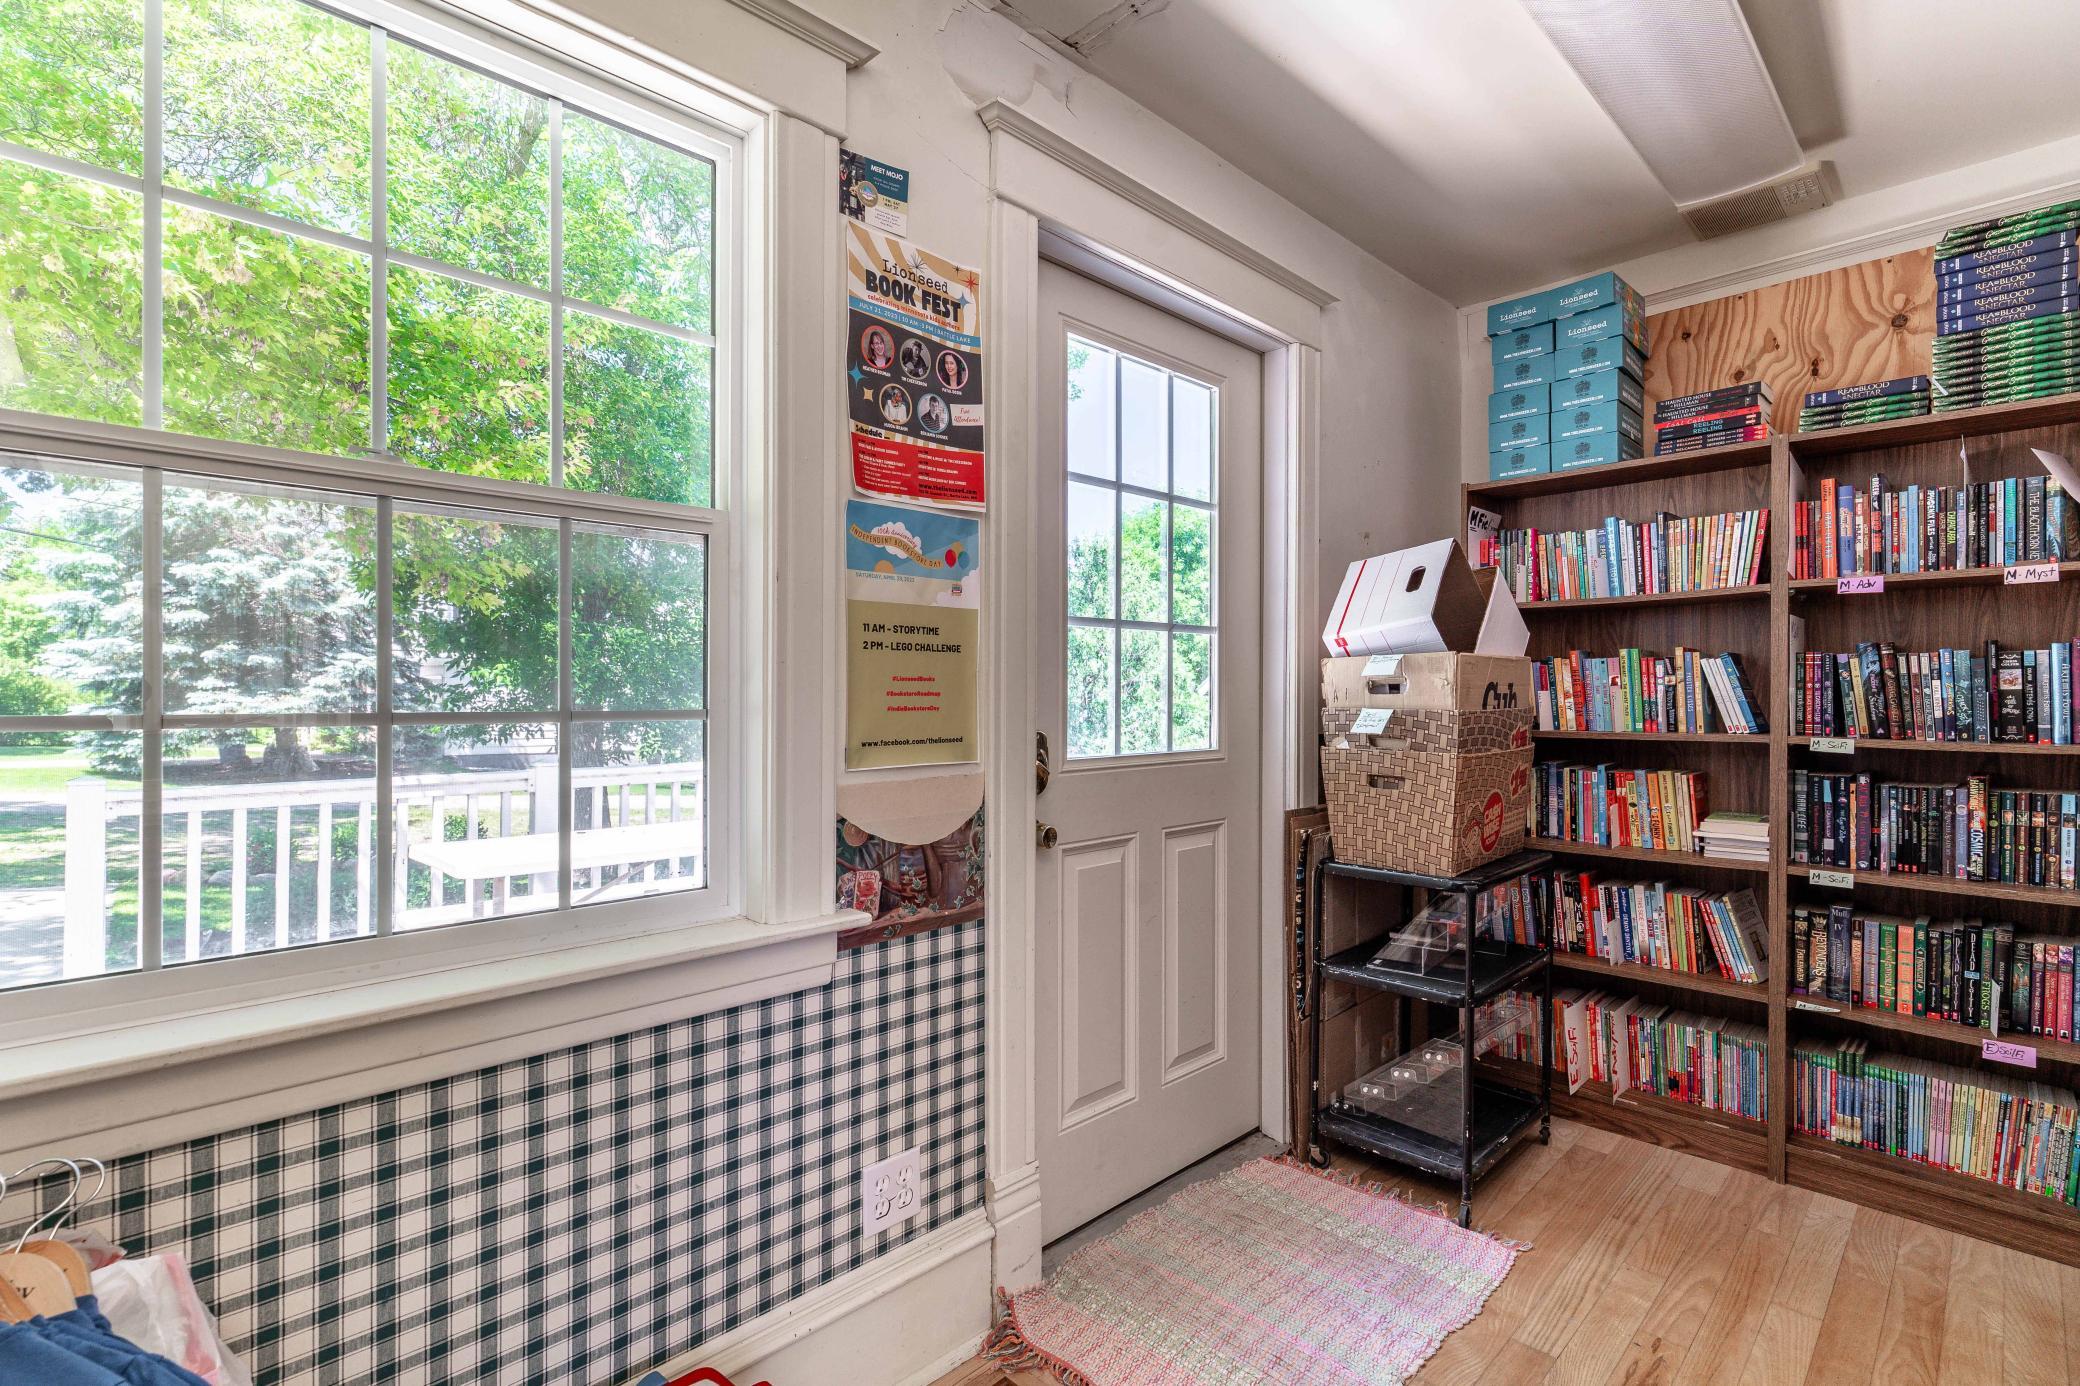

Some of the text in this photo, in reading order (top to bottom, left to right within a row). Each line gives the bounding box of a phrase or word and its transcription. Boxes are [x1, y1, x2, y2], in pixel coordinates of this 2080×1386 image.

[870, 164, 904, 180] MEET MOJO
[1973, 240, 2033, 260] REA BLOOD
[1985, 250, 2024, 263] NECTAR
[1977, 256, 2037, 274] REA BLOOD
[1987, 265, 2028, 278] NECTAR
[882, 259, 949, 294] Lionseed
[1976, 271, 2035, 290] REA BLOOD
[866, 268, 962, 322] BOOK FEST
[1986, 281, 2027, 294] NECTAR
[867, 294, 900, 310] celebrating
[1560, 288, 1599, 306] Lionseed
[1975, 288, 2034, 306] REA BLOOD
[1984, 298, 2025, 311] NECTAR
[1500, 306, 1536, 322] Lionseed
[1976, 304, 2036, 321] REA BLOOD
[1986, 313, 2026, 326] NECTAR
[859, 302, 872, 310] JULY
[956, 334, 971, 344] LAKE
[1568, 320, 1608, 336] Lionseed
[1838, 382, 1890, 396] REA BLOOD
[1846, 389, 1883, 400] NECTAR
[1666, 392, 1712, 406] HAUNTED HOUSE
[1674, 400, 1699, 408] HILLMAN
[1662, 405, 1708, 418] HAUNTED HOUSE
[1671, 412, 1696, 420] HILLMAN
[856, 424, 883, 438] Schedule
[1693, 425, 1722, 434] REELING
[1694, 419, 1723, 428] REELING
[2030, 492, 2040, 504] THE
[1928, 520, 1936, 536] FILES
[1947, 511, 1956, 546] CHUPACABRA
[2028, 506, 2040, 549] BLACKTHORN
[852, 526, 941, 568] INDEPENDENT BOOKSTORE DAY
[2006, 568, 2056, 582] M Myst
[1840, 580, 1877, 592] M Adv
[863, 624, 870, 632] 11
[872, 624, 885, 633] AM
[892, 624, 940, 636] STORYTIME
[863, 641, 868, 650] 2
[870, 642, 883, 650] PM
[890, 642, 912, 651] LEGO
[914, 643, 962, 653] CHALLENGE
[1571, 670, 1581, 687] HERE
[2042, 674, 2050, 700] ARTEMIS
[2061, 663, 2071, 720] ARTEMIS FOWL
[1574, 702, 1585, 718] STAY
[2026, 684, 2034, 722] ARTEMIS FOWL
[861, 736, 963, 748] www.facebook.com/thelionseed
[1812, 740, 1820, 750] M
[1828, 740, 1848, 750] SciFi
[1970, 780, 1980, 810] HAWKING
[1796, 794, 1806, 830] DARK LIFE
[1652, 820, 1661, 840] FUNNY
[1970, 828, 1984, 856] COSMIC
[1812, 872, 1821, 883] M
[1832, 908, 1850, 918] Mull
[1622, 914, 1630, 932] DEMON
[1834, 922, 1844, 931] IV
[1811, 930, 1828, 977] BEYONDERS
[1796, 948, 1806, 982] FABLEHAVEN
[1982, 981, 1991, 1010] FROGS
[1567, 1026, 1580, 1086] E Sci/Fi
[1986, 1043, 1997, 1054] E
